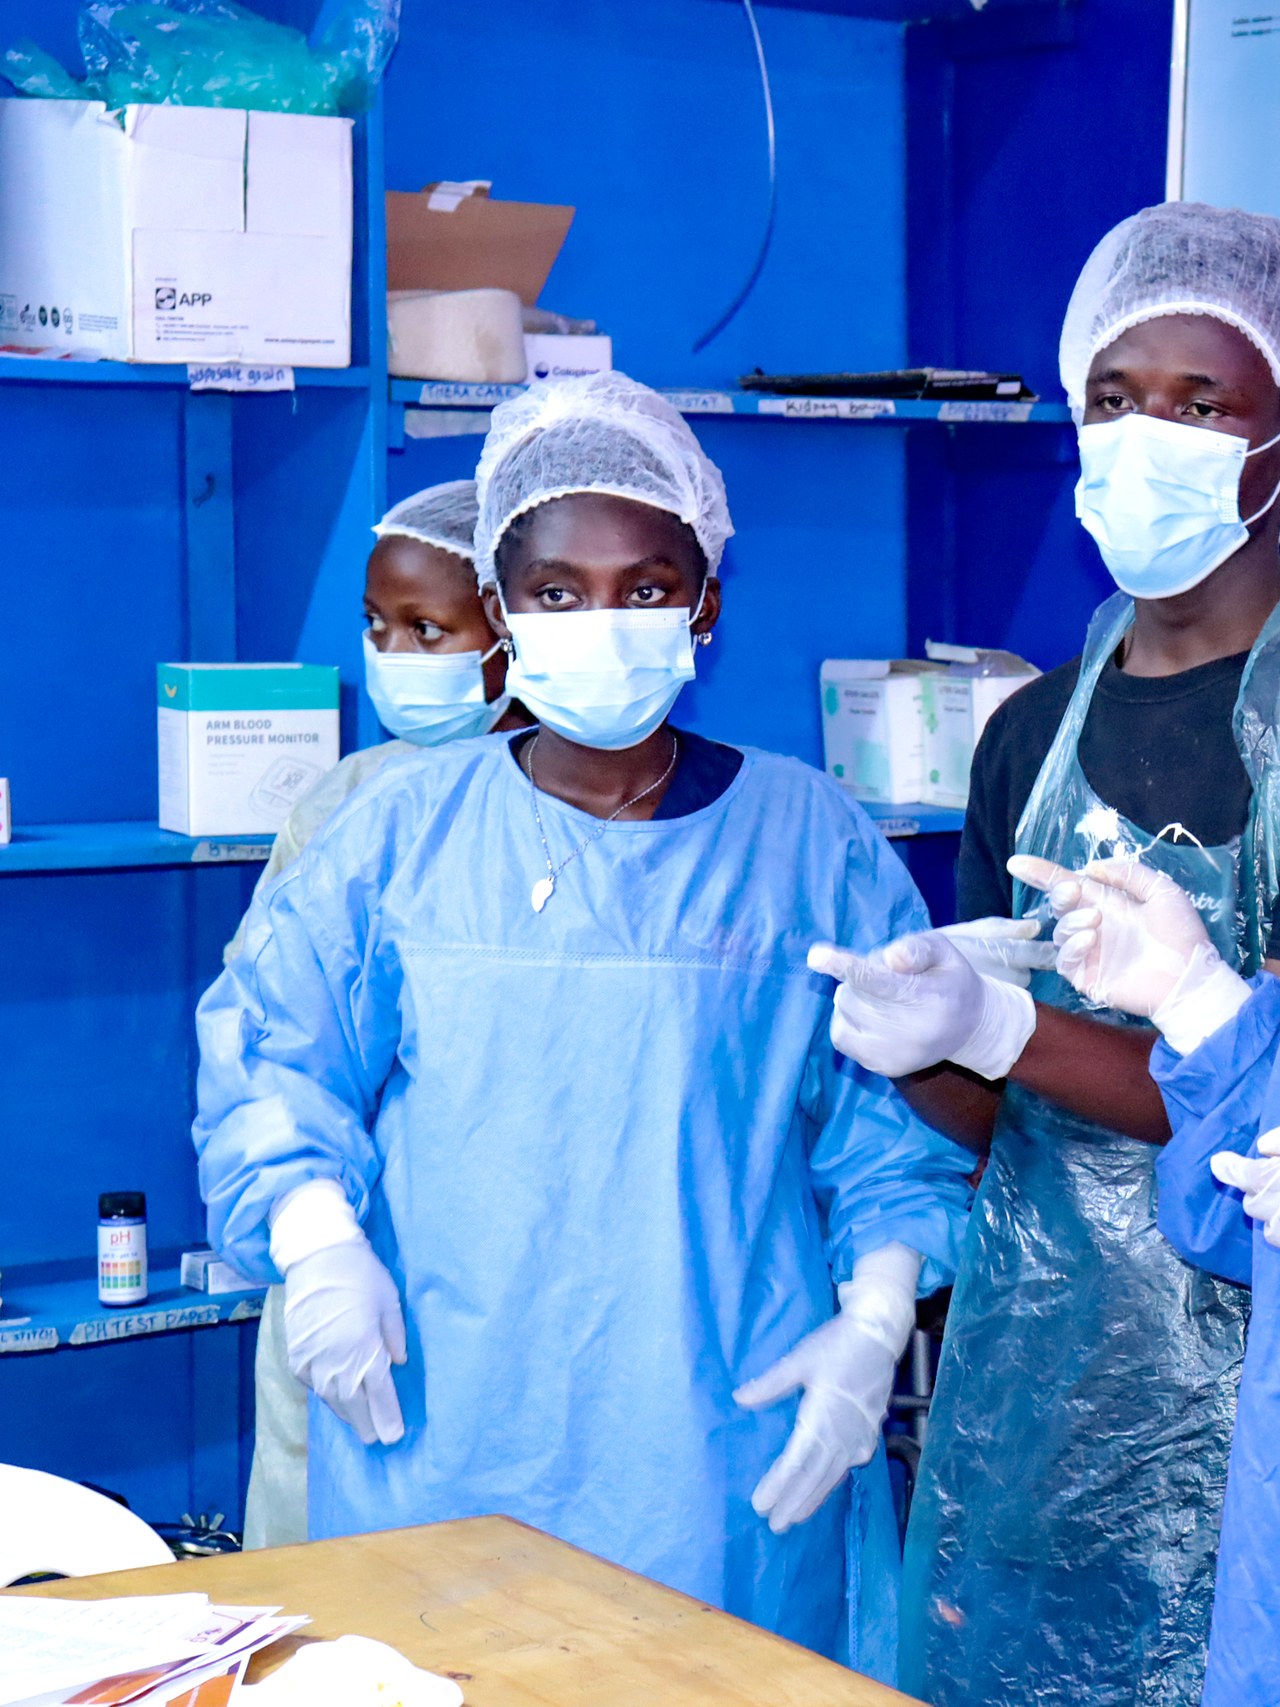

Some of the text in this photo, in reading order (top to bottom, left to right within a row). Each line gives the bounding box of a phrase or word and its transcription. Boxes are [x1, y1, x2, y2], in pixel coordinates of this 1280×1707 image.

[179, 293, 212, 307] APP
[206, 719, 272, 730] ARM BLOOD
[206, 732, 319, 745] PRESSURE MONITOR
[111, 1230, 132, 1247] pH
